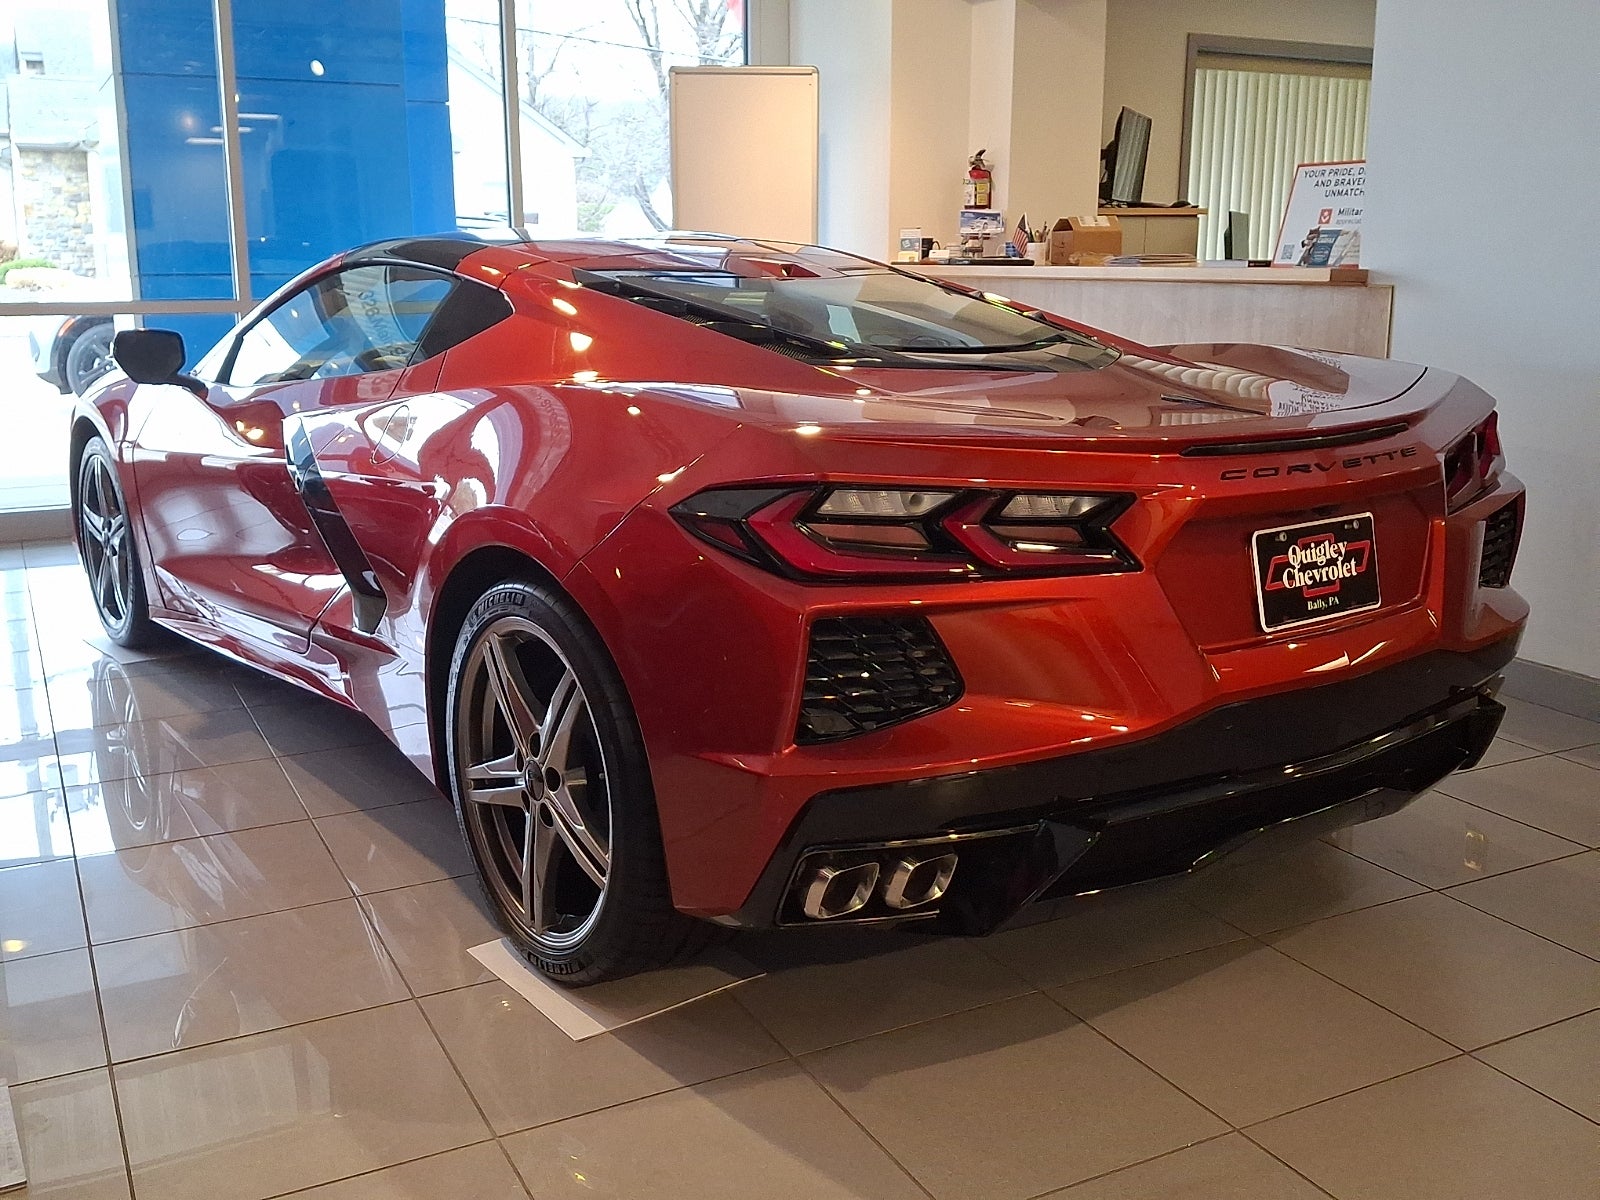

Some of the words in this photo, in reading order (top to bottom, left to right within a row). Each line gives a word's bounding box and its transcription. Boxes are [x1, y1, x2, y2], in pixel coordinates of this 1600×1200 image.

[1304, 169, 1325, 178] YOUR
[1328, 167, 1356, 177] PRIDE,
[1314, 179, 1332, 188] AND
[1338, 207, 1364, 216] Militar
[1220, 446, 1417, 481] CORVETTE
[1287, 539, 1348, 569] Quigley
[1282, 558, 1357, 589] Chevrolet
[477, 592, 525, 616] MICHELIN
[1307, 599, 1328, 611] Bally,
[1328, 596, 1340, 607] PA
